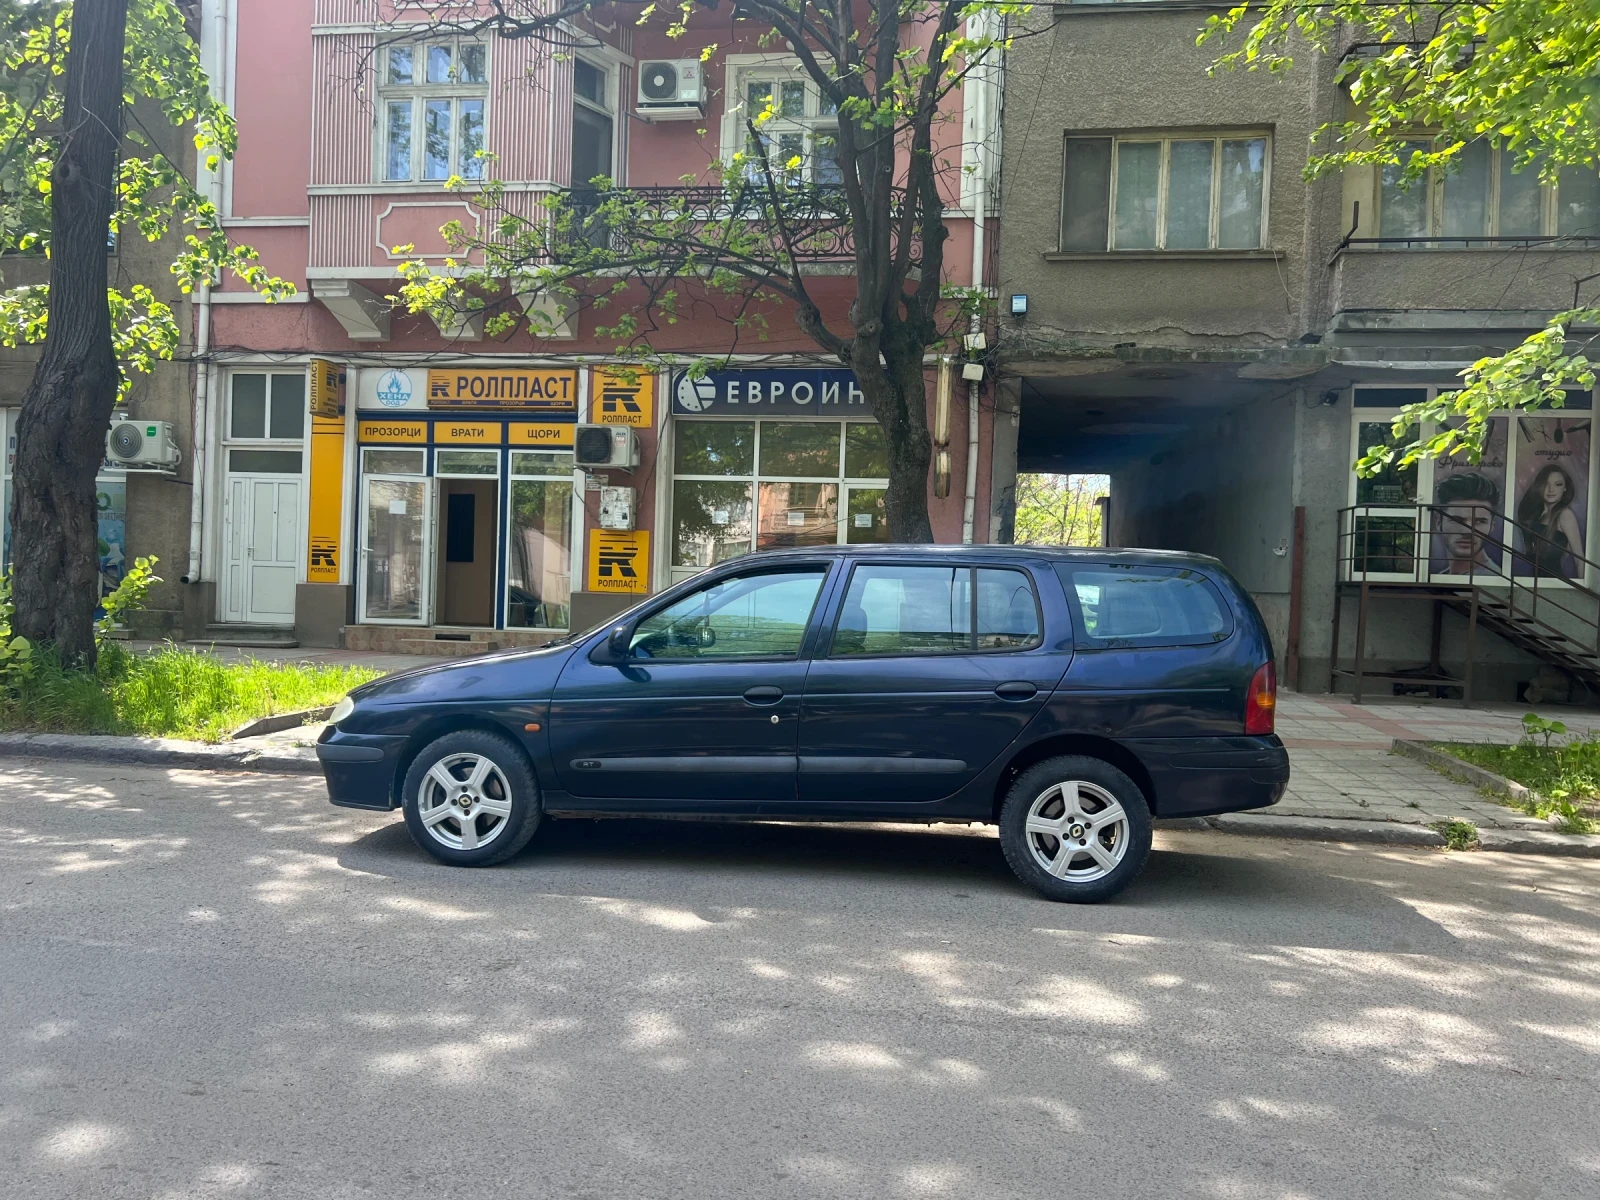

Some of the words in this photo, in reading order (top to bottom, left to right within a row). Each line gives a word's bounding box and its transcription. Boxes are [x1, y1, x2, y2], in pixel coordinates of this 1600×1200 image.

[456, 376, 572, 398] РОЛПЛАСТ
[602, 414, 642, 423] РОЛПЛАСТ
[364, 427, 421, 438] ПРОЗОРЦИ
[451, 428, 485, 437] ВРАТИ
[527, 429, 561, 439] ЩОРИ
[1534, 449, 1573, 460] студио
[597, 579, 637, 588] РОЛПЛАСТ
